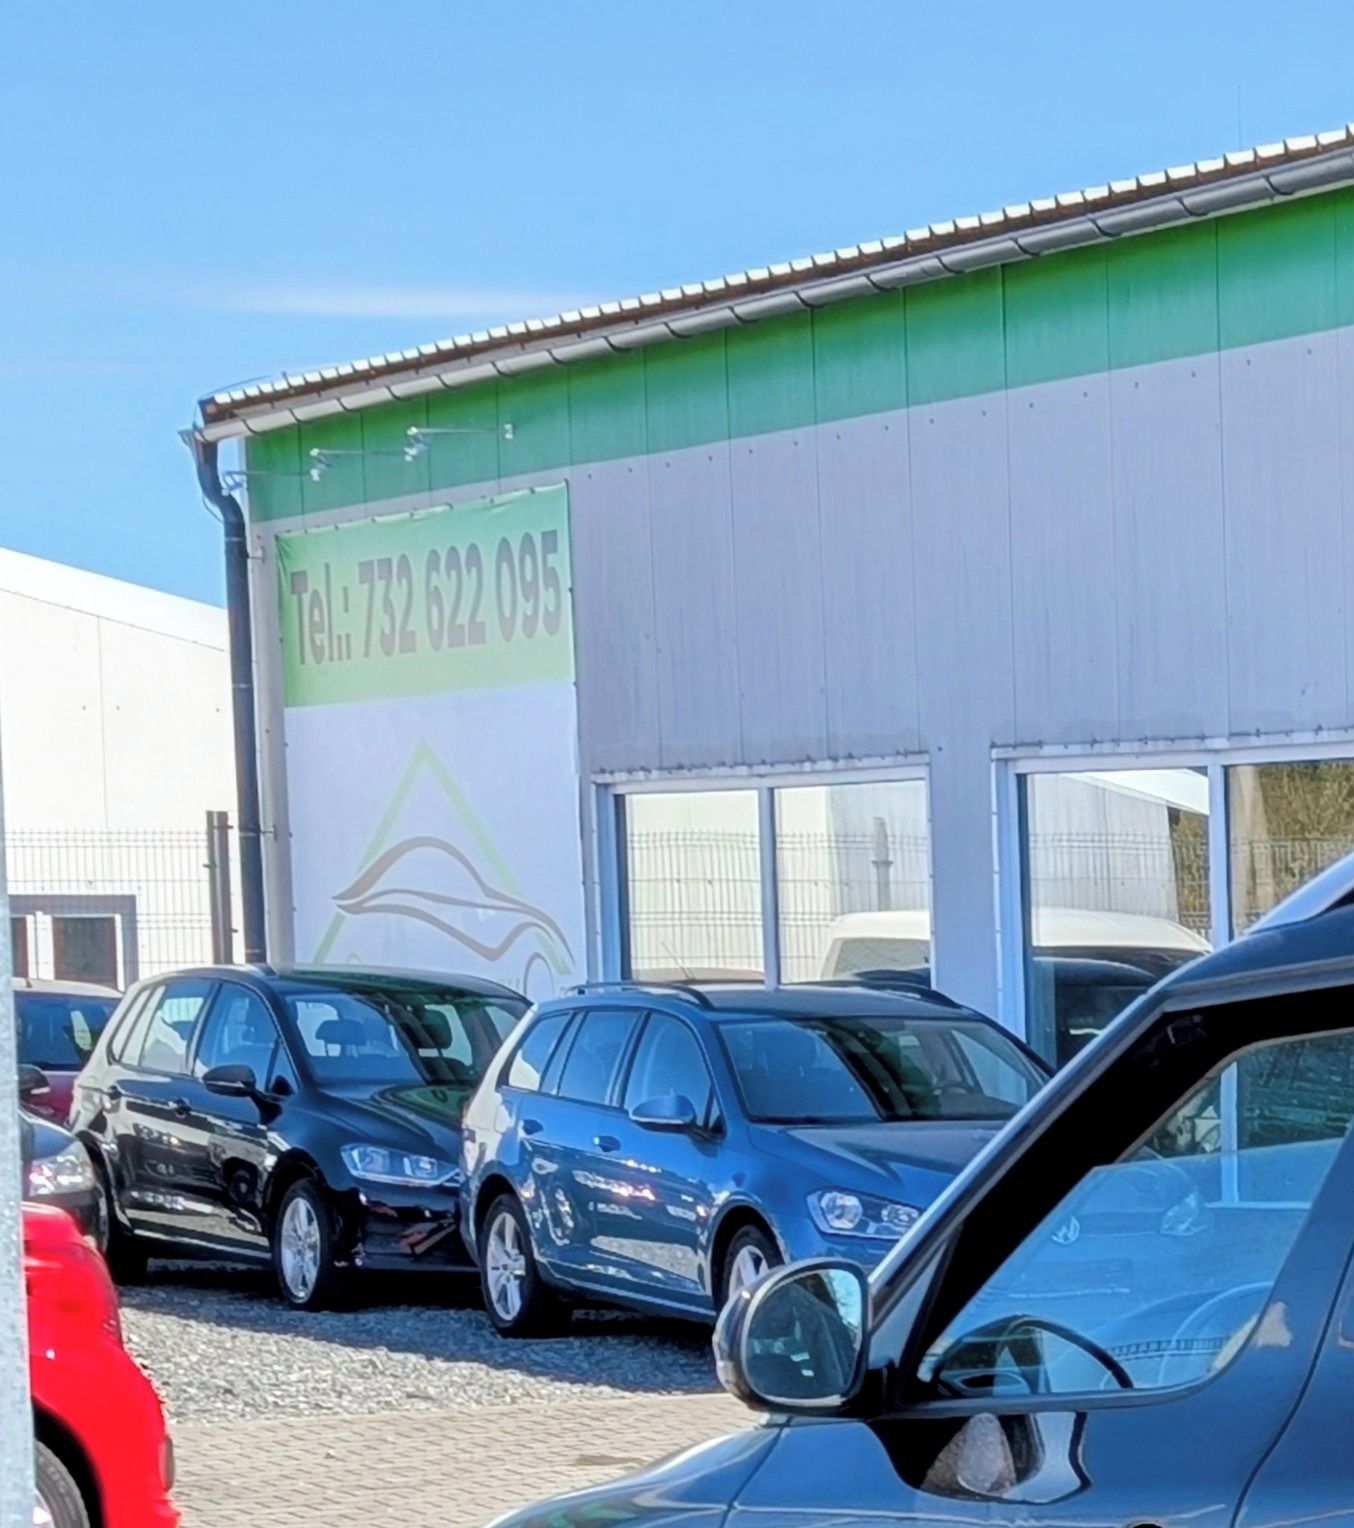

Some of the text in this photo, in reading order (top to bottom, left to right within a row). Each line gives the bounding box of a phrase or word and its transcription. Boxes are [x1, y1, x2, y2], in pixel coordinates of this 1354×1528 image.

[290, 529, 562, 665] Tel.: 732 622 095
